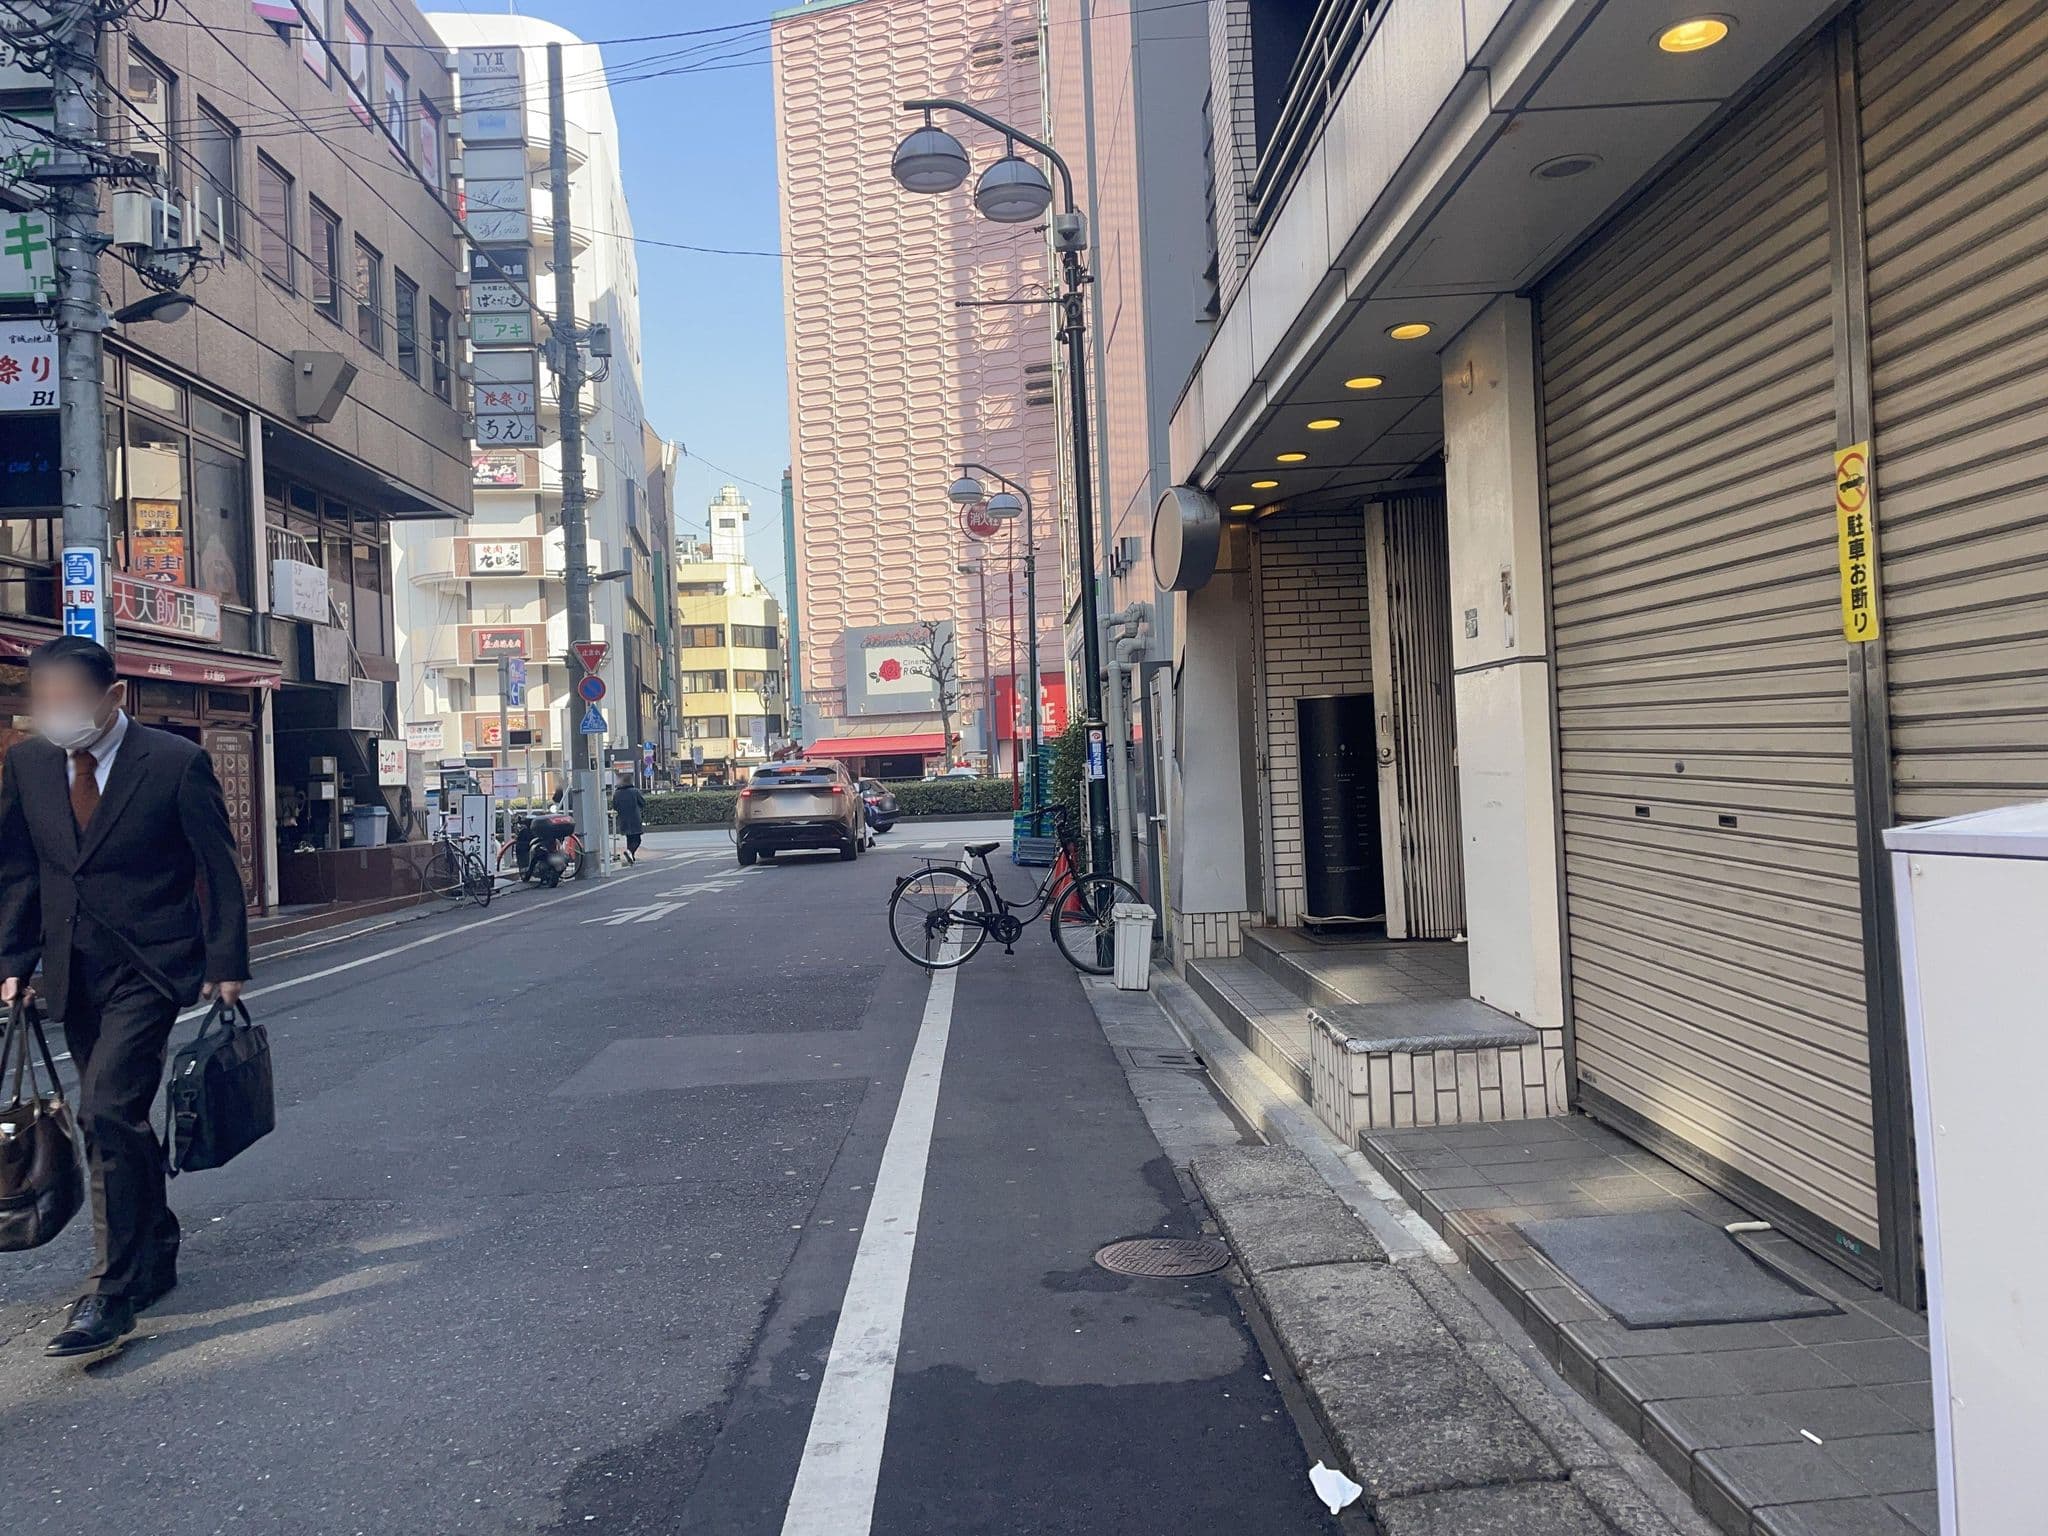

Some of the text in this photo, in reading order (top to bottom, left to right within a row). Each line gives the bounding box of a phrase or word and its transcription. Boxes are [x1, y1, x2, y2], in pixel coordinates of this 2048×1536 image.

[494, 323, 524, 338] アキ
[30, 391, 54, 406] B1
[483, 391, 528, 407] 花祭り
[485, 418, 523, 440] ちえ
[65, 554, 93, 584] 質
[1847, 513, 1867, 633] 駐車お断り
[114, 580, 194, 632] 天天飯店
